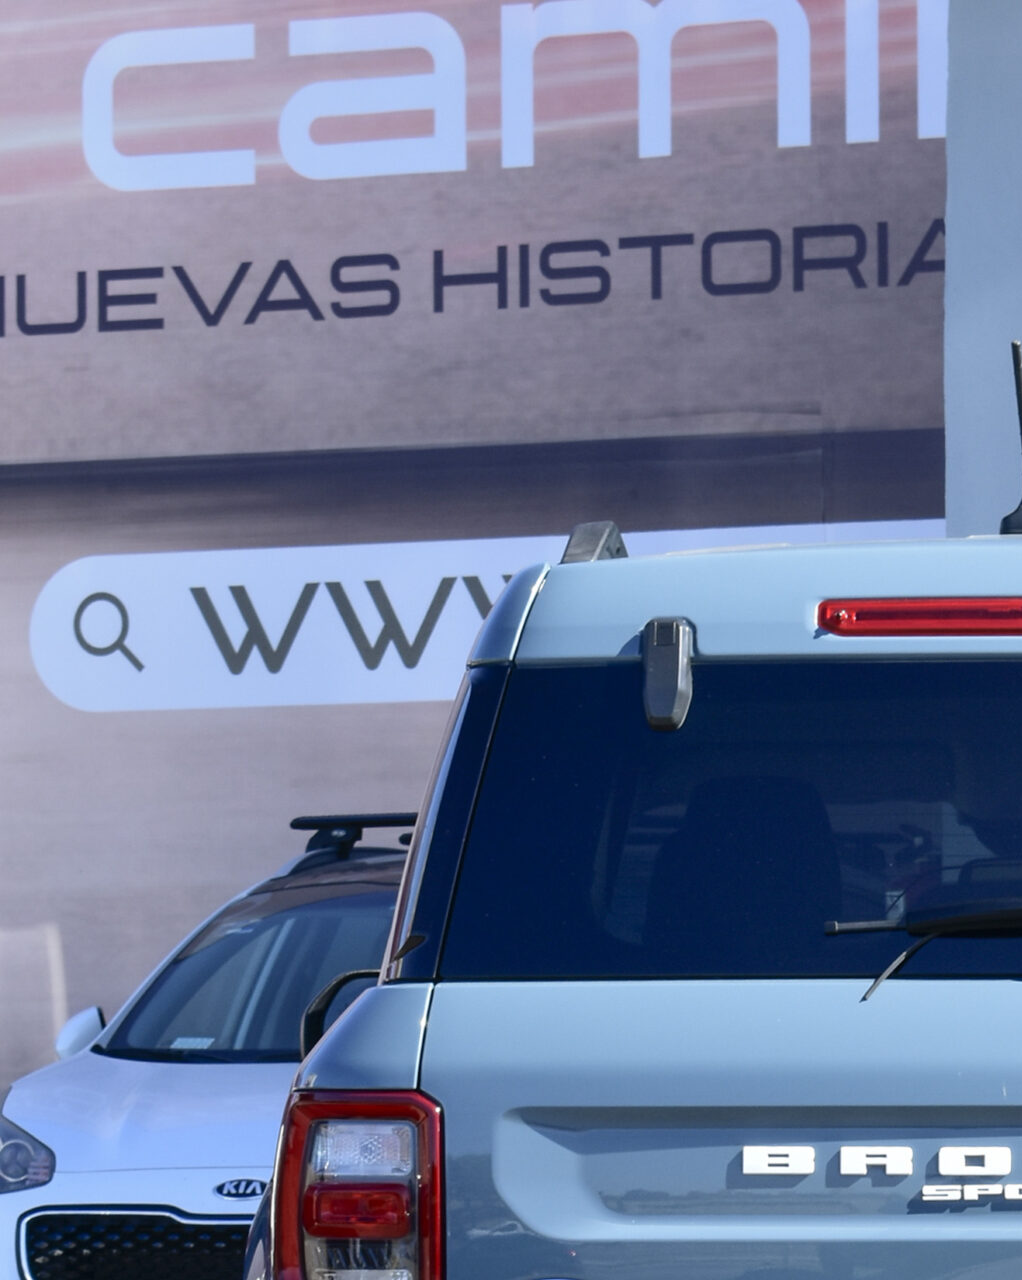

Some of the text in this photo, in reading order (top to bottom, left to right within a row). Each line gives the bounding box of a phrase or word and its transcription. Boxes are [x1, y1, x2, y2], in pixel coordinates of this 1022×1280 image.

[82, 0, 948, 192] cami
[0, 253, 401, 338] UEVAS
[222, 1180, 262, 1195] KIA
